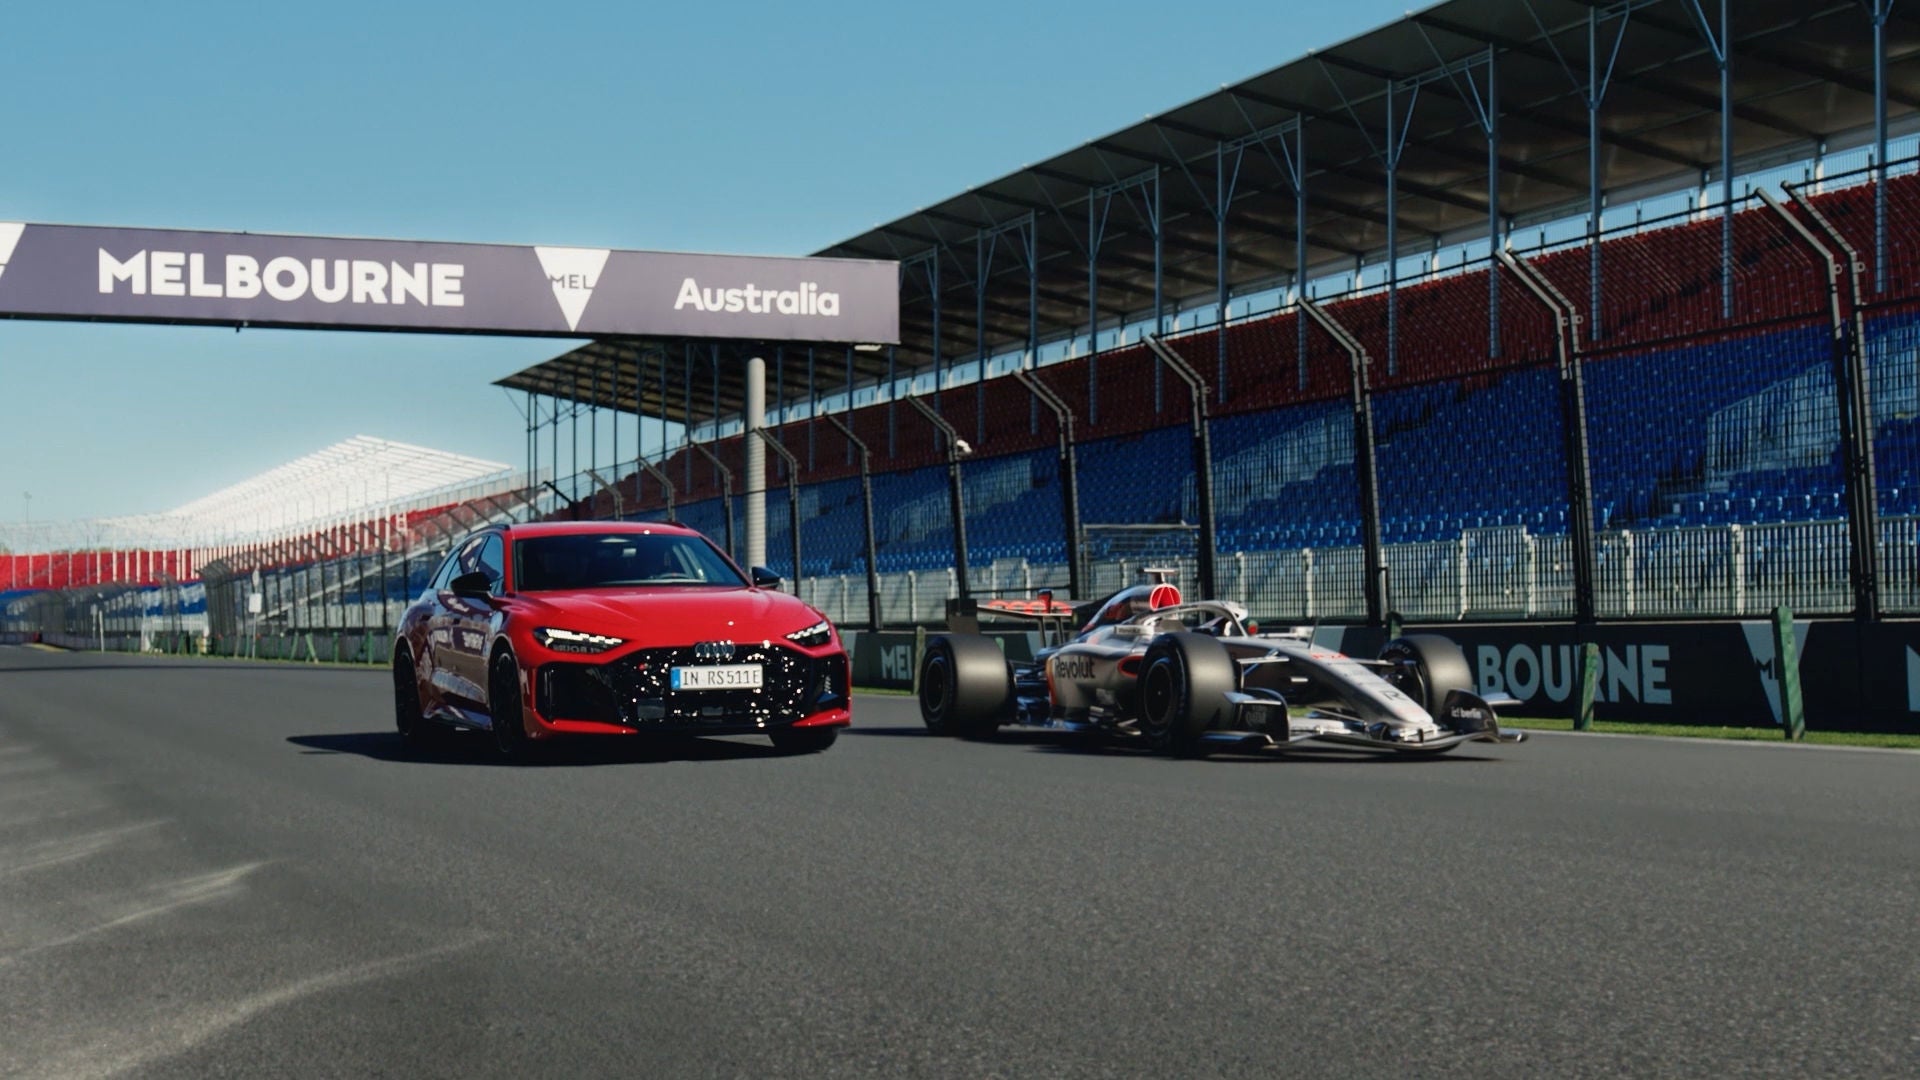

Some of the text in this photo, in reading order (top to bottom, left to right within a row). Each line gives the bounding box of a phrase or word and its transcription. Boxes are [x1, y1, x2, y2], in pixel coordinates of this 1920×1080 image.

[98, 247, 465, 307] MELBOURNE
[550, 273, 595, 290] MEL
[674, 278, 839, 317] Australia
[683, 672, 699, 685] IN
[1055, 655, 1096, 679] Revolut
